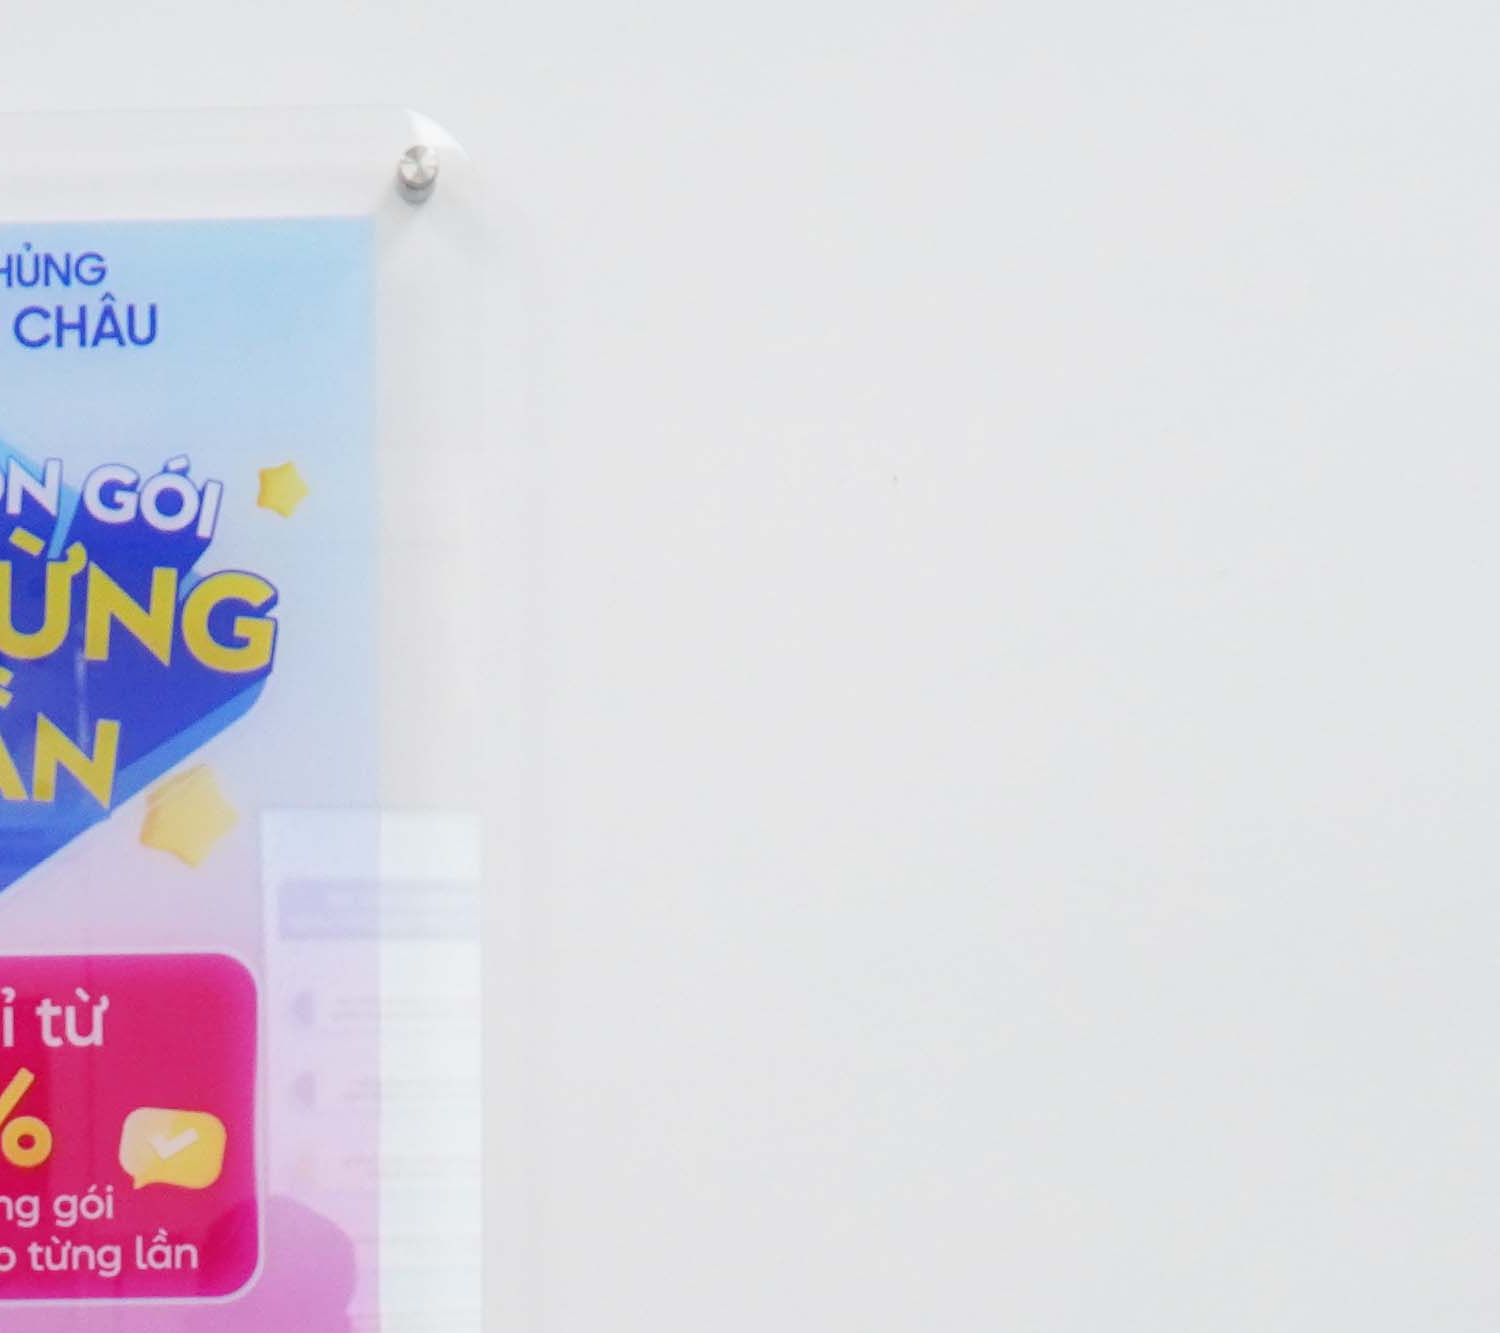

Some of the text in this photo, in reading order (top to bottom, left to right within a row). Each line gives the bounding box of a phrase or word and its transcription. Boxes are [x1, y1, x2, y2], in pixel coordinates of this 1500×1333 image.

[12, 291, 159, 349] CHÂU
[82, 453, 224, 540] GÓI
[35, 987, 110, 1048] từ
[52, 1185, 115, 1228] gói
[28, 1236, 122, 1278] từng
[134, 1229, 199, 1271] lần
